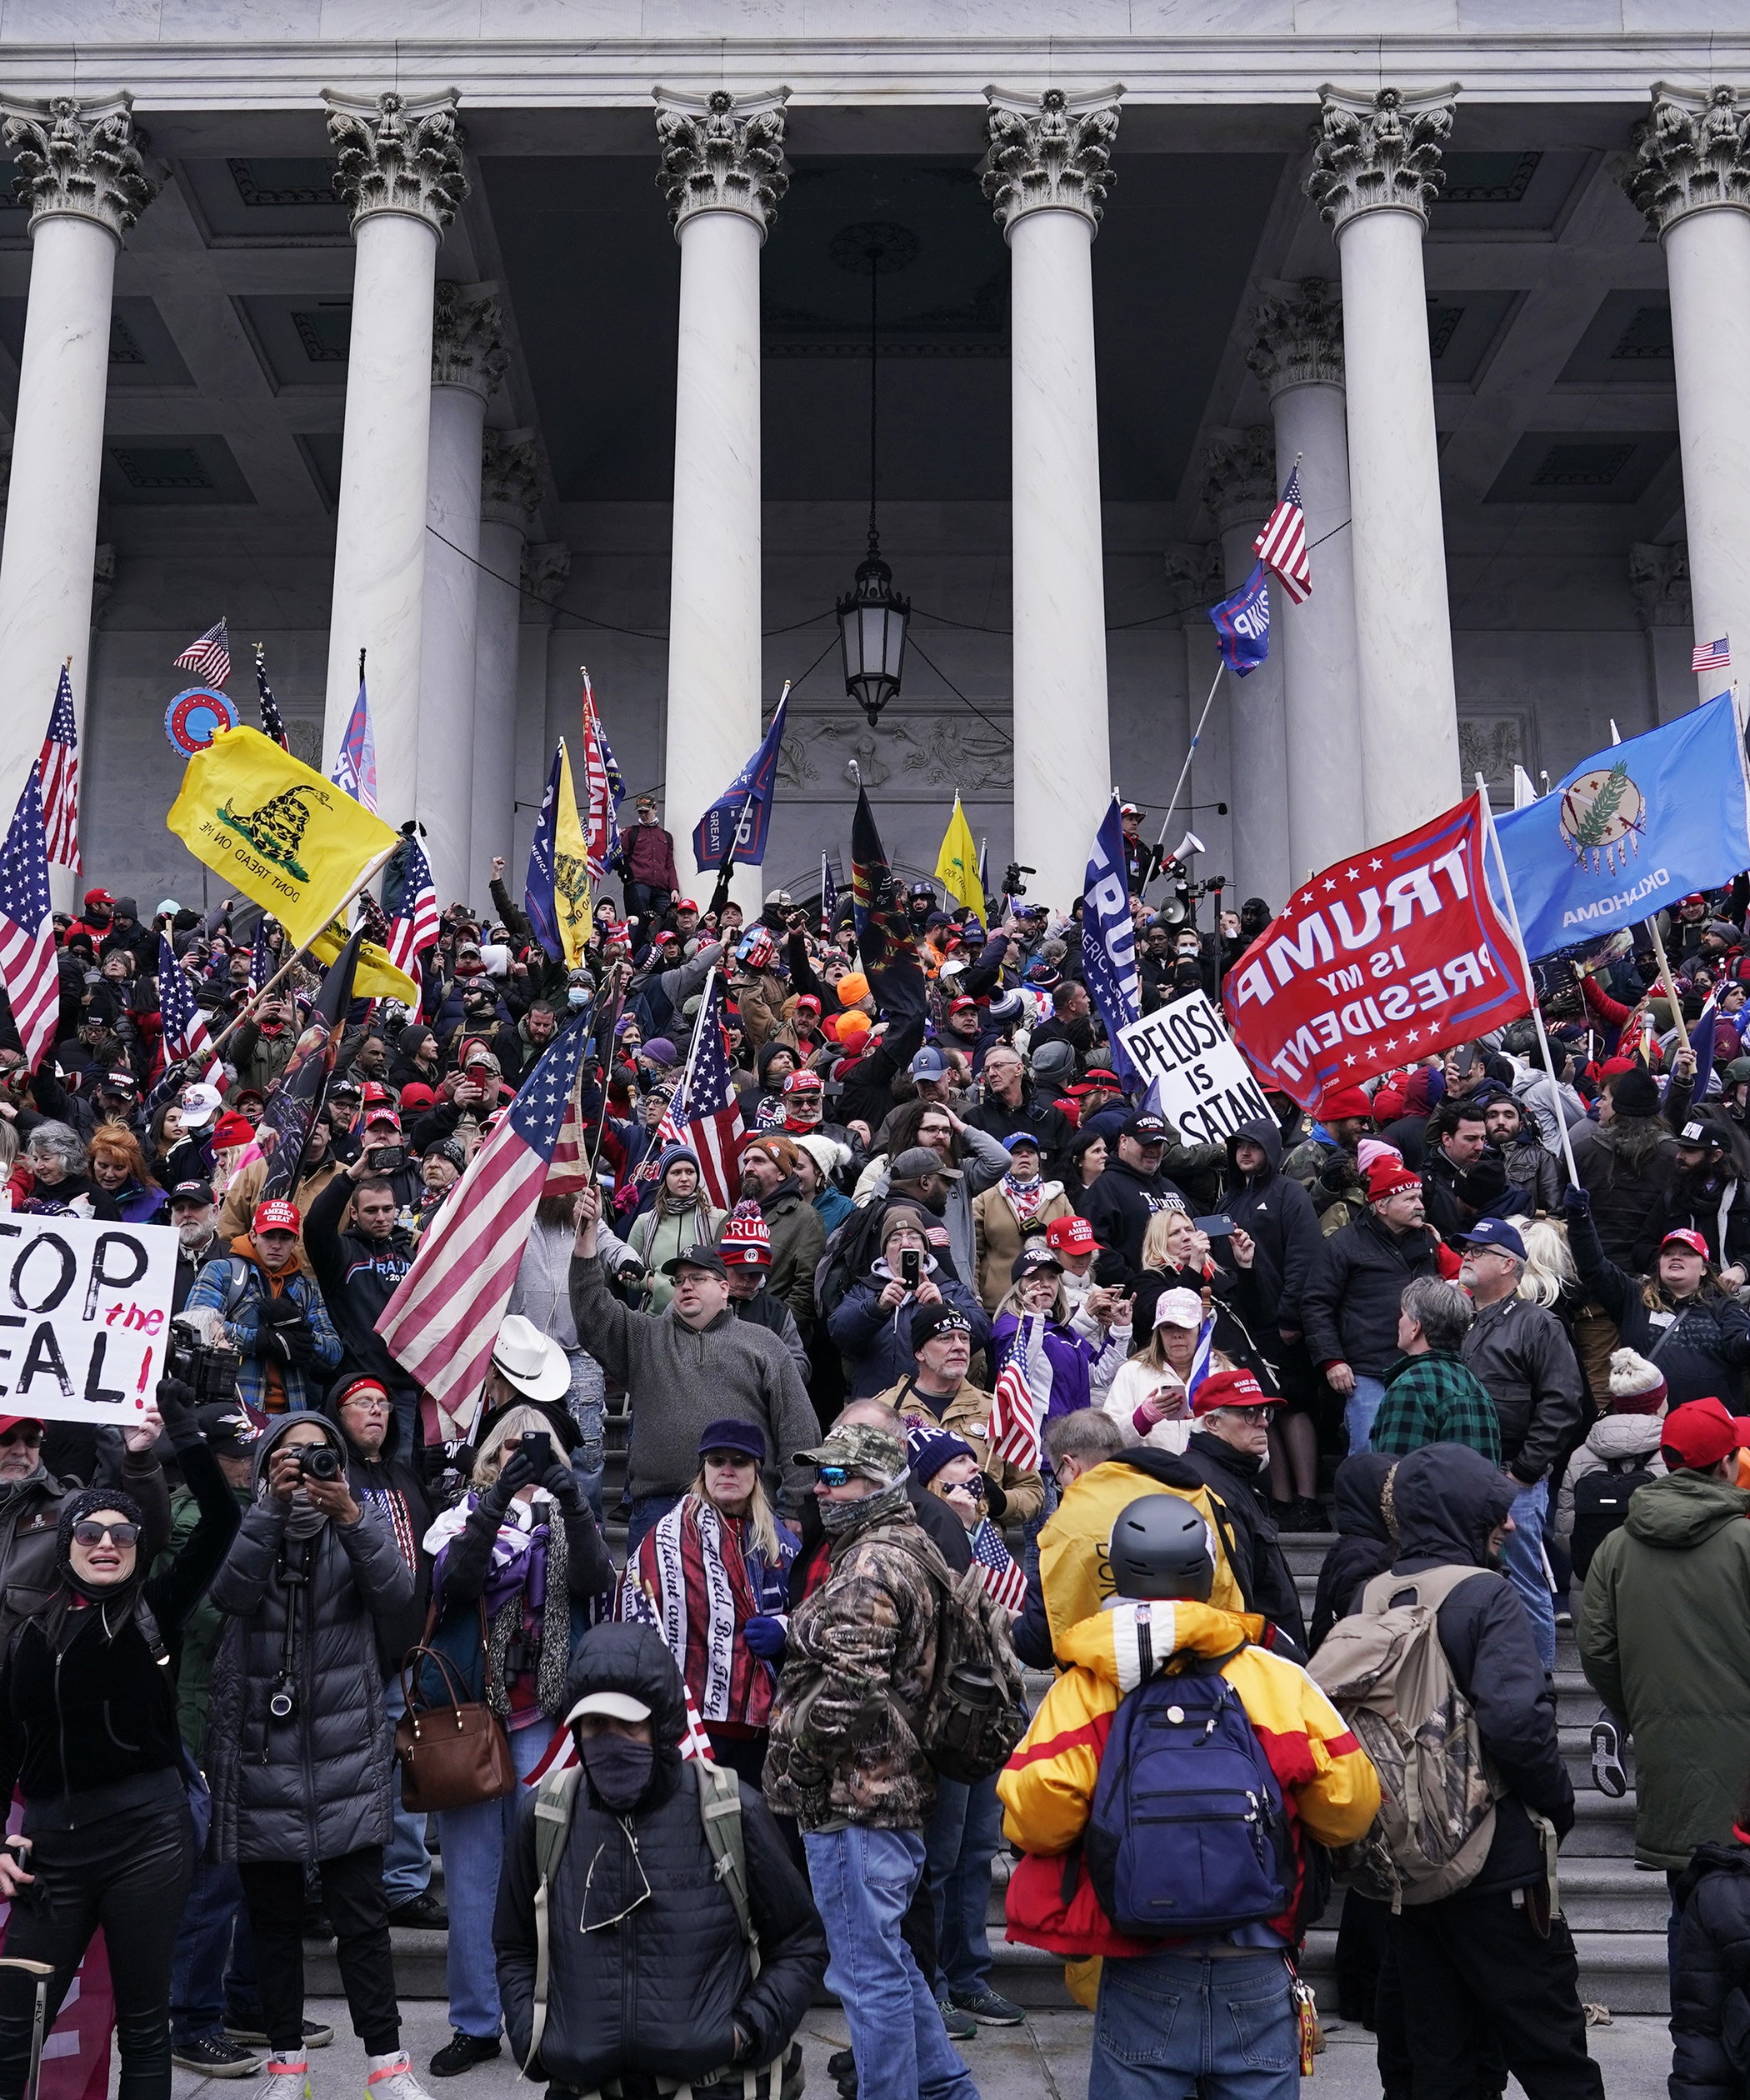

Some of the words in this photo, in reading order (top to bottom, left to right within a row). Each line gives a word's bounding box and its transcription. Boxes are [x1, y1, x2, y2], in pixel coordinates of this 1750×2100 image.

[710, 810, 721, 852] GREAT!
[749, 931, 773, 944] TRUMP
[1084, 834, 1141, 1019] TRUM
[1128, 999, 1227, 1077] PELOSI
[108, 1072, 134, 1085] TRUMP
[1184, 1063, 1214, 1095] IS
[1136, 1117, 1164, 1128] TRUMP
[1179, 1076, 1272, 1145] SATAN
[1139, 1191, 1186, 1214] Trump
[1389, 1181, 1423, 1195] TRUMP
[262, 1209, 294, 1219] AMERICA
[267, 1215, 291, 1223] GREAT
[1050, 1233, 1060, 1245] 45
[105, 1302, 164, 1336] the
[667, 1604, 679, 1654] arms
[712, 1618, 733, 1661] But
[704, 1665, 728, 1721] They
